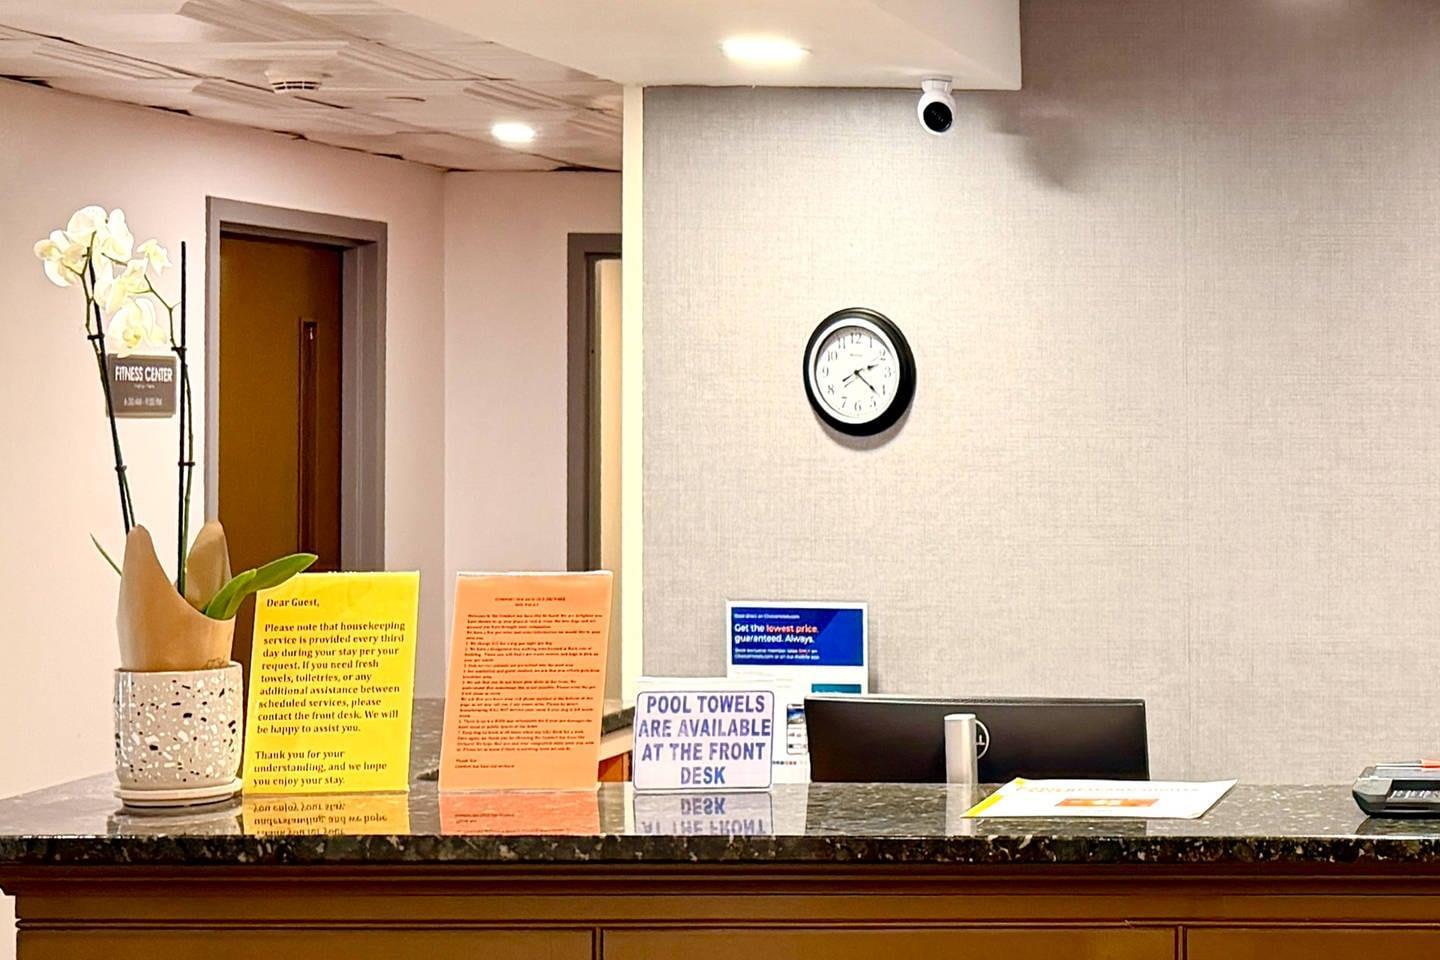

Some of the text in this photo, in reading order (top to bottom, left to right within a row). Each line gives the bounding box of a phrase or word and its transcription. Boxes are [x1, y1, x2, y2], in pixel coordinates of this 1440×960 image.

[115, 365, 173, 383] FITNESS CENTER
[266, 598, 320, 607] Dear Guest,
[264, 621, 406, 632] Please note that housekeeping
[734, 623, 749, 633] Get
[750, 624, 765, 632] the
[766, 624, 794, 633] lowest
[263, 633, 404, 645] service is provided every third
[734, 635, 784, 644] guaranteed.
[262, 648, 399, 658] day during your stay per your
[261, 659, 379, 672] request. If you need fresh
[261, 674, 294, 683] towels,
[296, 673, 341, 682] toiletries,
[355, 673, 372, 682] any
[259, 684, 400, 696] additional assistance between
[258, 698, 382, 709] scheduled services, please
[646, 695, 765, 714] POOL TOWELS
[257, 709, 399, 721] contact the front desk. We will
[256, 724, 361, 736] be happy to assist you.
[638, 718, 771, 737] ARE AVAILABLE
[255, 750, 346, 761] Thank you for your
[641, 743, 766, 761] AT THE FRONT
[254, 761, 387, 774] understanding, and we hope
[253, 778, 270, 788] you
[272, 776, 299, 788] enjoy
[300, 777, 322, 787] your
[680, 767, 726, 785] DESK
